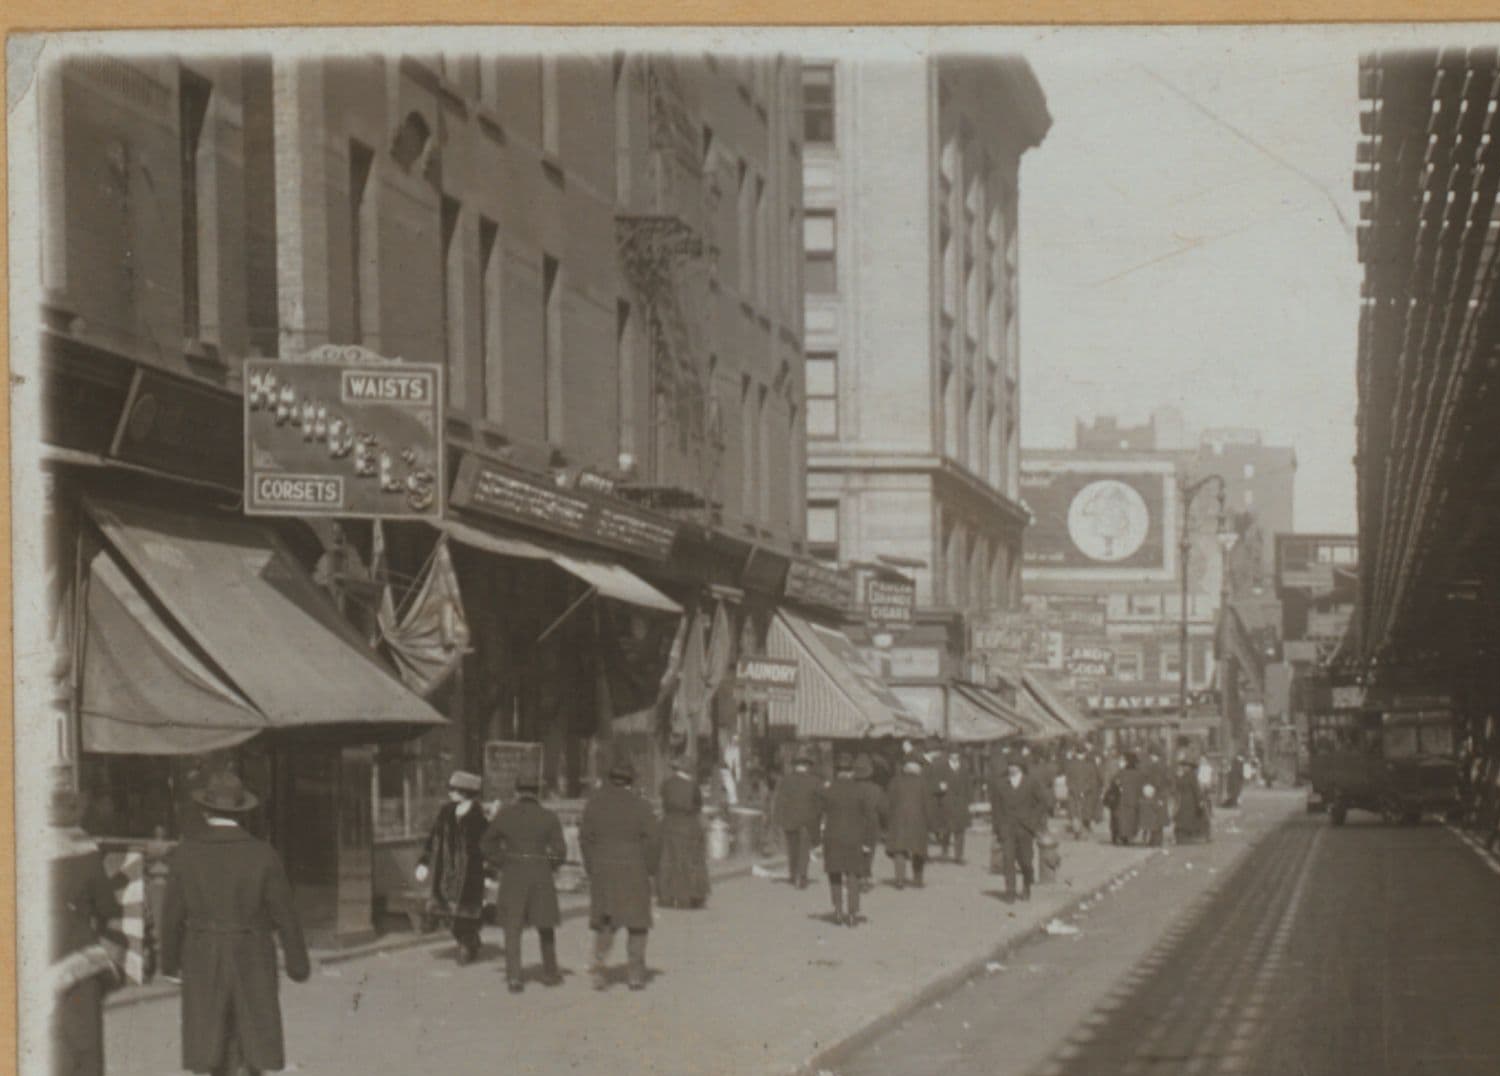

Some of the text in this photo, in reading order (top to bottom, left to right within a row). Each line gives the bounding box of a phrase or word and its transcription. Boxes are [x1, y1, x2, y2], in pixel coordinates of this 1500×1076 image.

[350, 377, 423, 398] WAISTS
[260, 478, 337, 502] CORSETS
[736, 660, 798, 683] LAUNDRY
